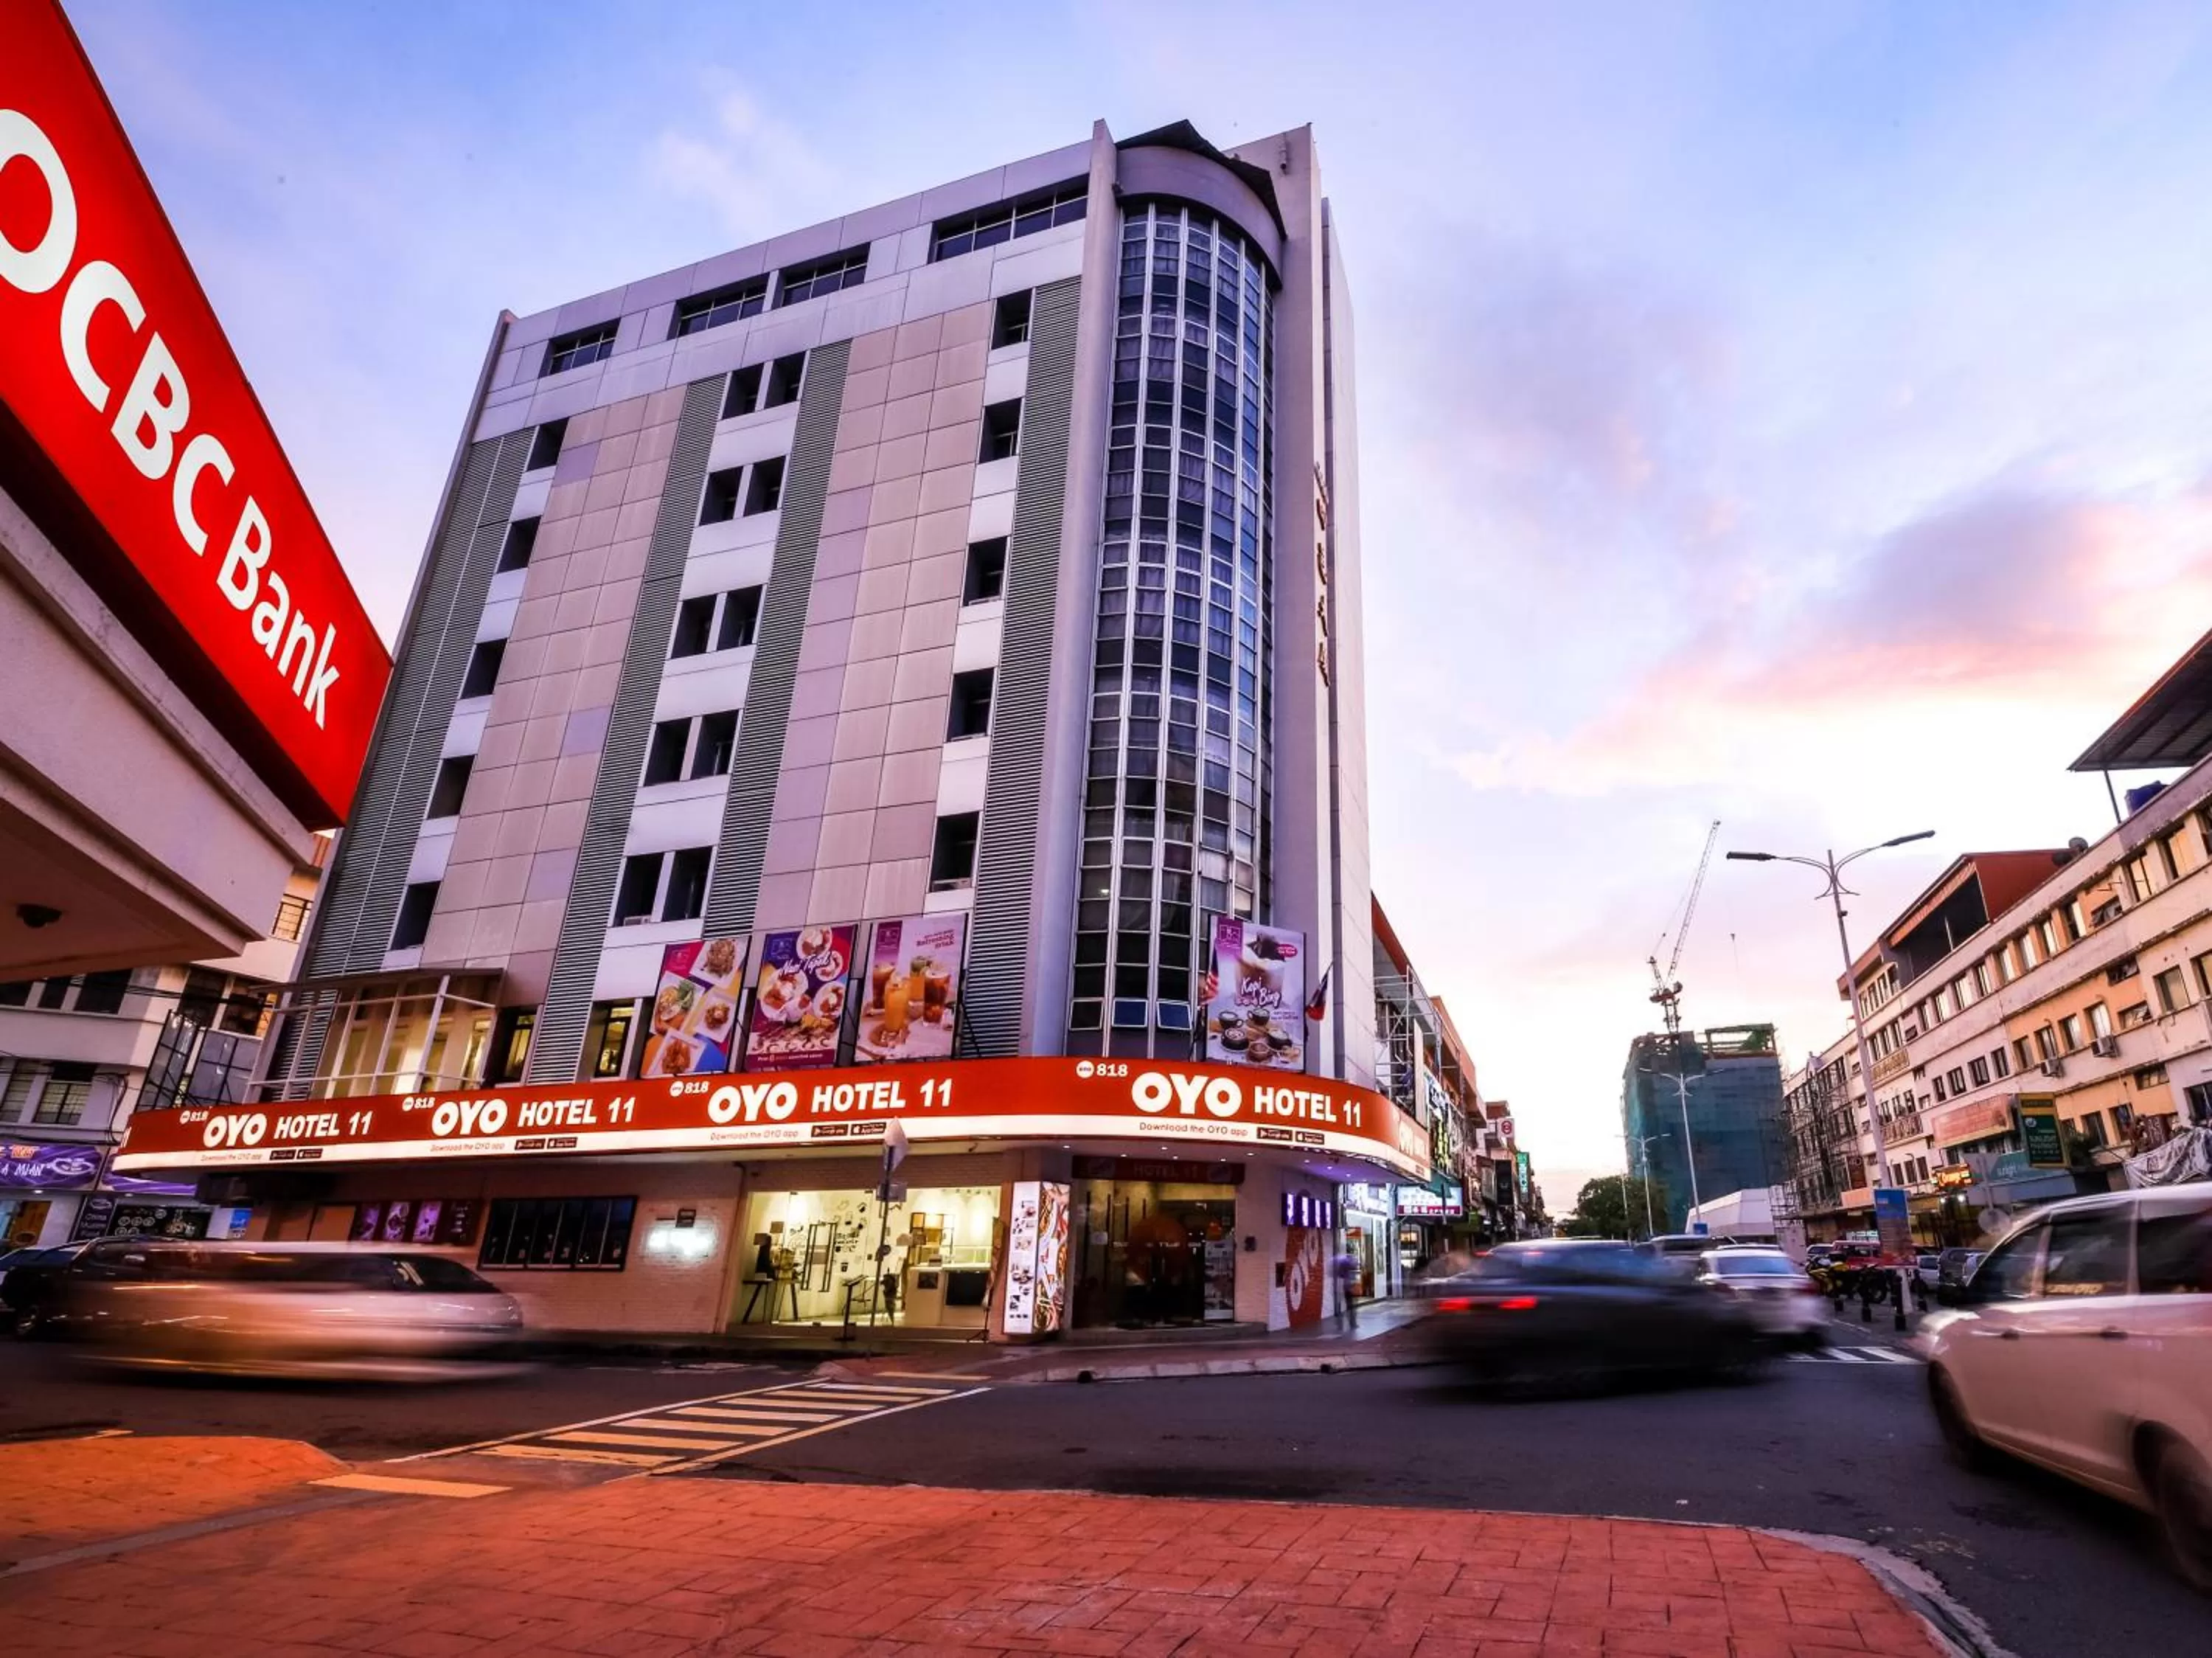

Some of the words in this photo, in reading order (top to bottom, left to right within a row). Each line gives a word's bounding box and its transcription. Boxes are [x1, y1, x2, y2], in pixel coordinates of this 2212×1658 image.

[0, 108, 234, 557] OCBC
[217, 495, 342, 729] Bank
[684, 1081, 709, 1095] 818
[1096, 1064, 1128, 1077] 818
[431, 1099, 508, 1137] OYO
[518, 1099, 597, 1128] HOTEL
[608, 1097, 636, 1123] 11
[707, 1081, 798, 1124] OYO
[811, 1081, 906, 1113] HOTEL
[919, 1078, 953, 1107] 11
[1131, 1072, 1242, 1117] OYO
[1254, 1086, 1337, 1122] HOTEL
[1343, 1100, 1362, 1128] 11
[203, 1113, 268, 1148] OYO
[274, 1113, 341, 1139] HOTEL
[349, 1111, 373, 1135] 11
[1139, 1122, 1188, 1132] Download
[1190, 1125, 1204, 1134] the
[1207, 1125, 1228, 1134] OYO
[1231, 1128, 1248, 1137] app
